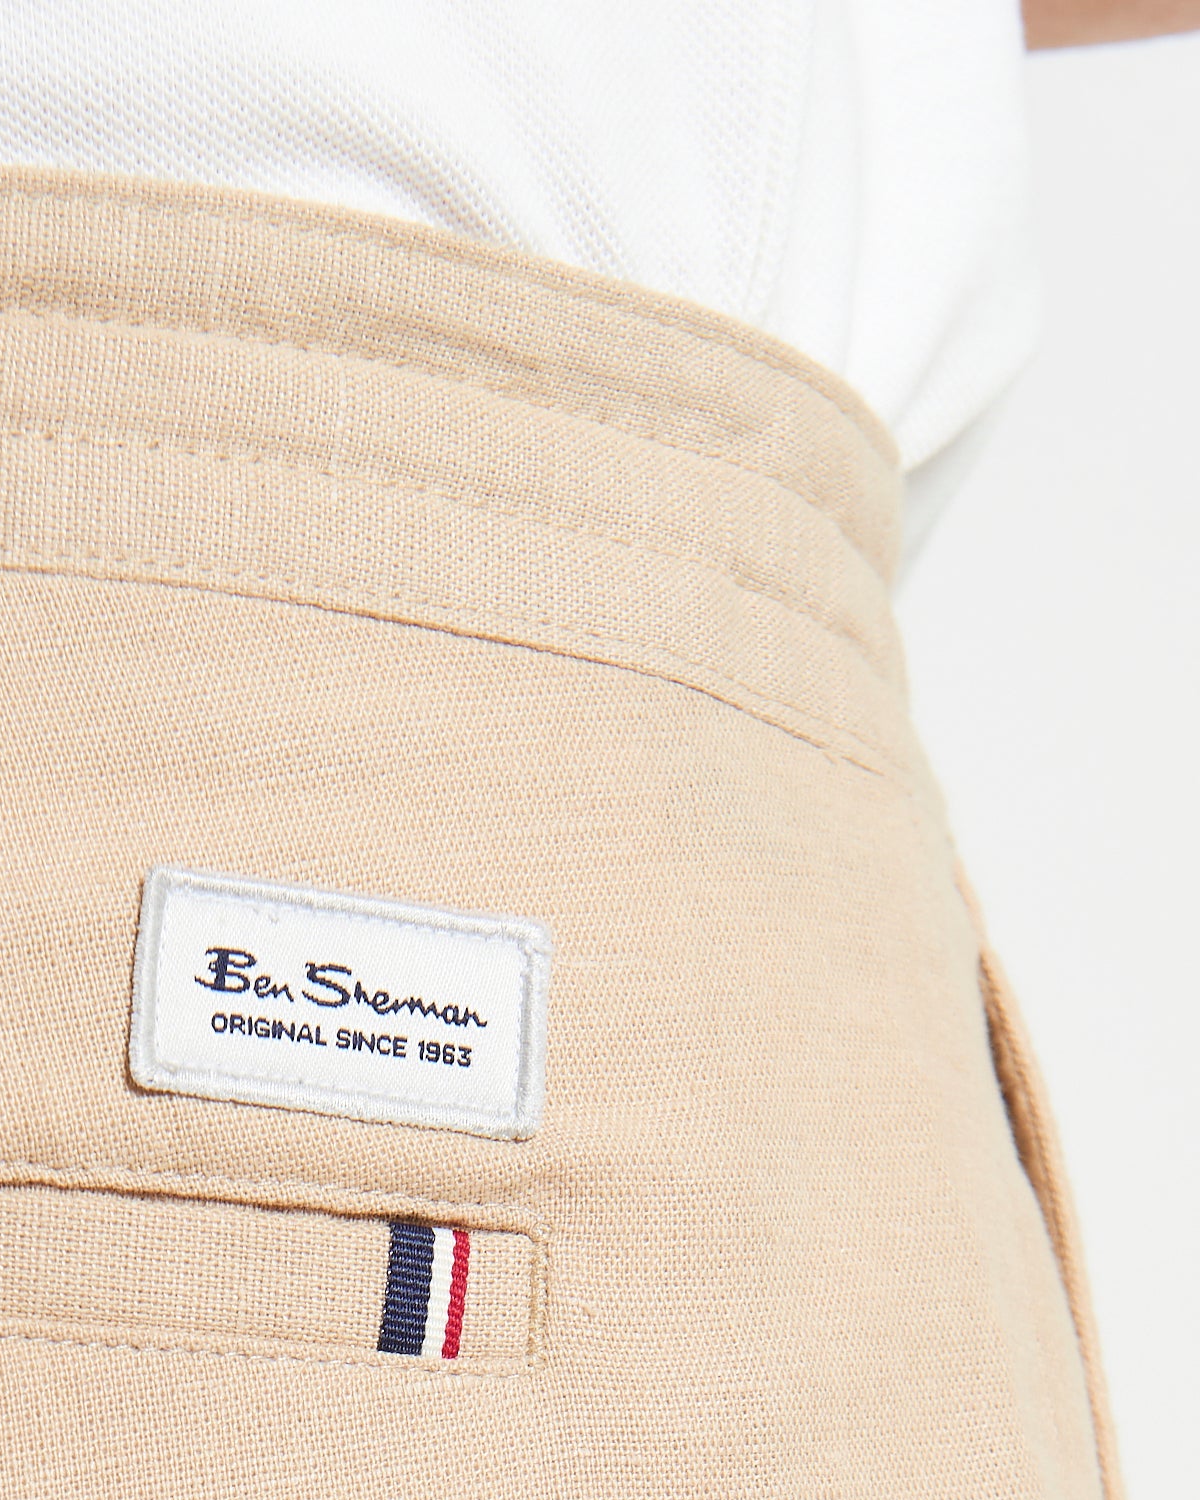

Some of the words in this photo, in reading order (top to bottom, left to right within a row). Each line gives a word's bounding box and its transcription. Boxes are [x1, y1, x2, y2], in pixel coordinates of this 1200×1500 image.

[194, 946, 295, 1003] Ben
[301, 961, 489, 1028] Sherman
[210, 1012, 328, 1047] ORIGINAL
[335, 1028, 408, 1059] SINCE
[417, 1039, 473, 1068] 1963
